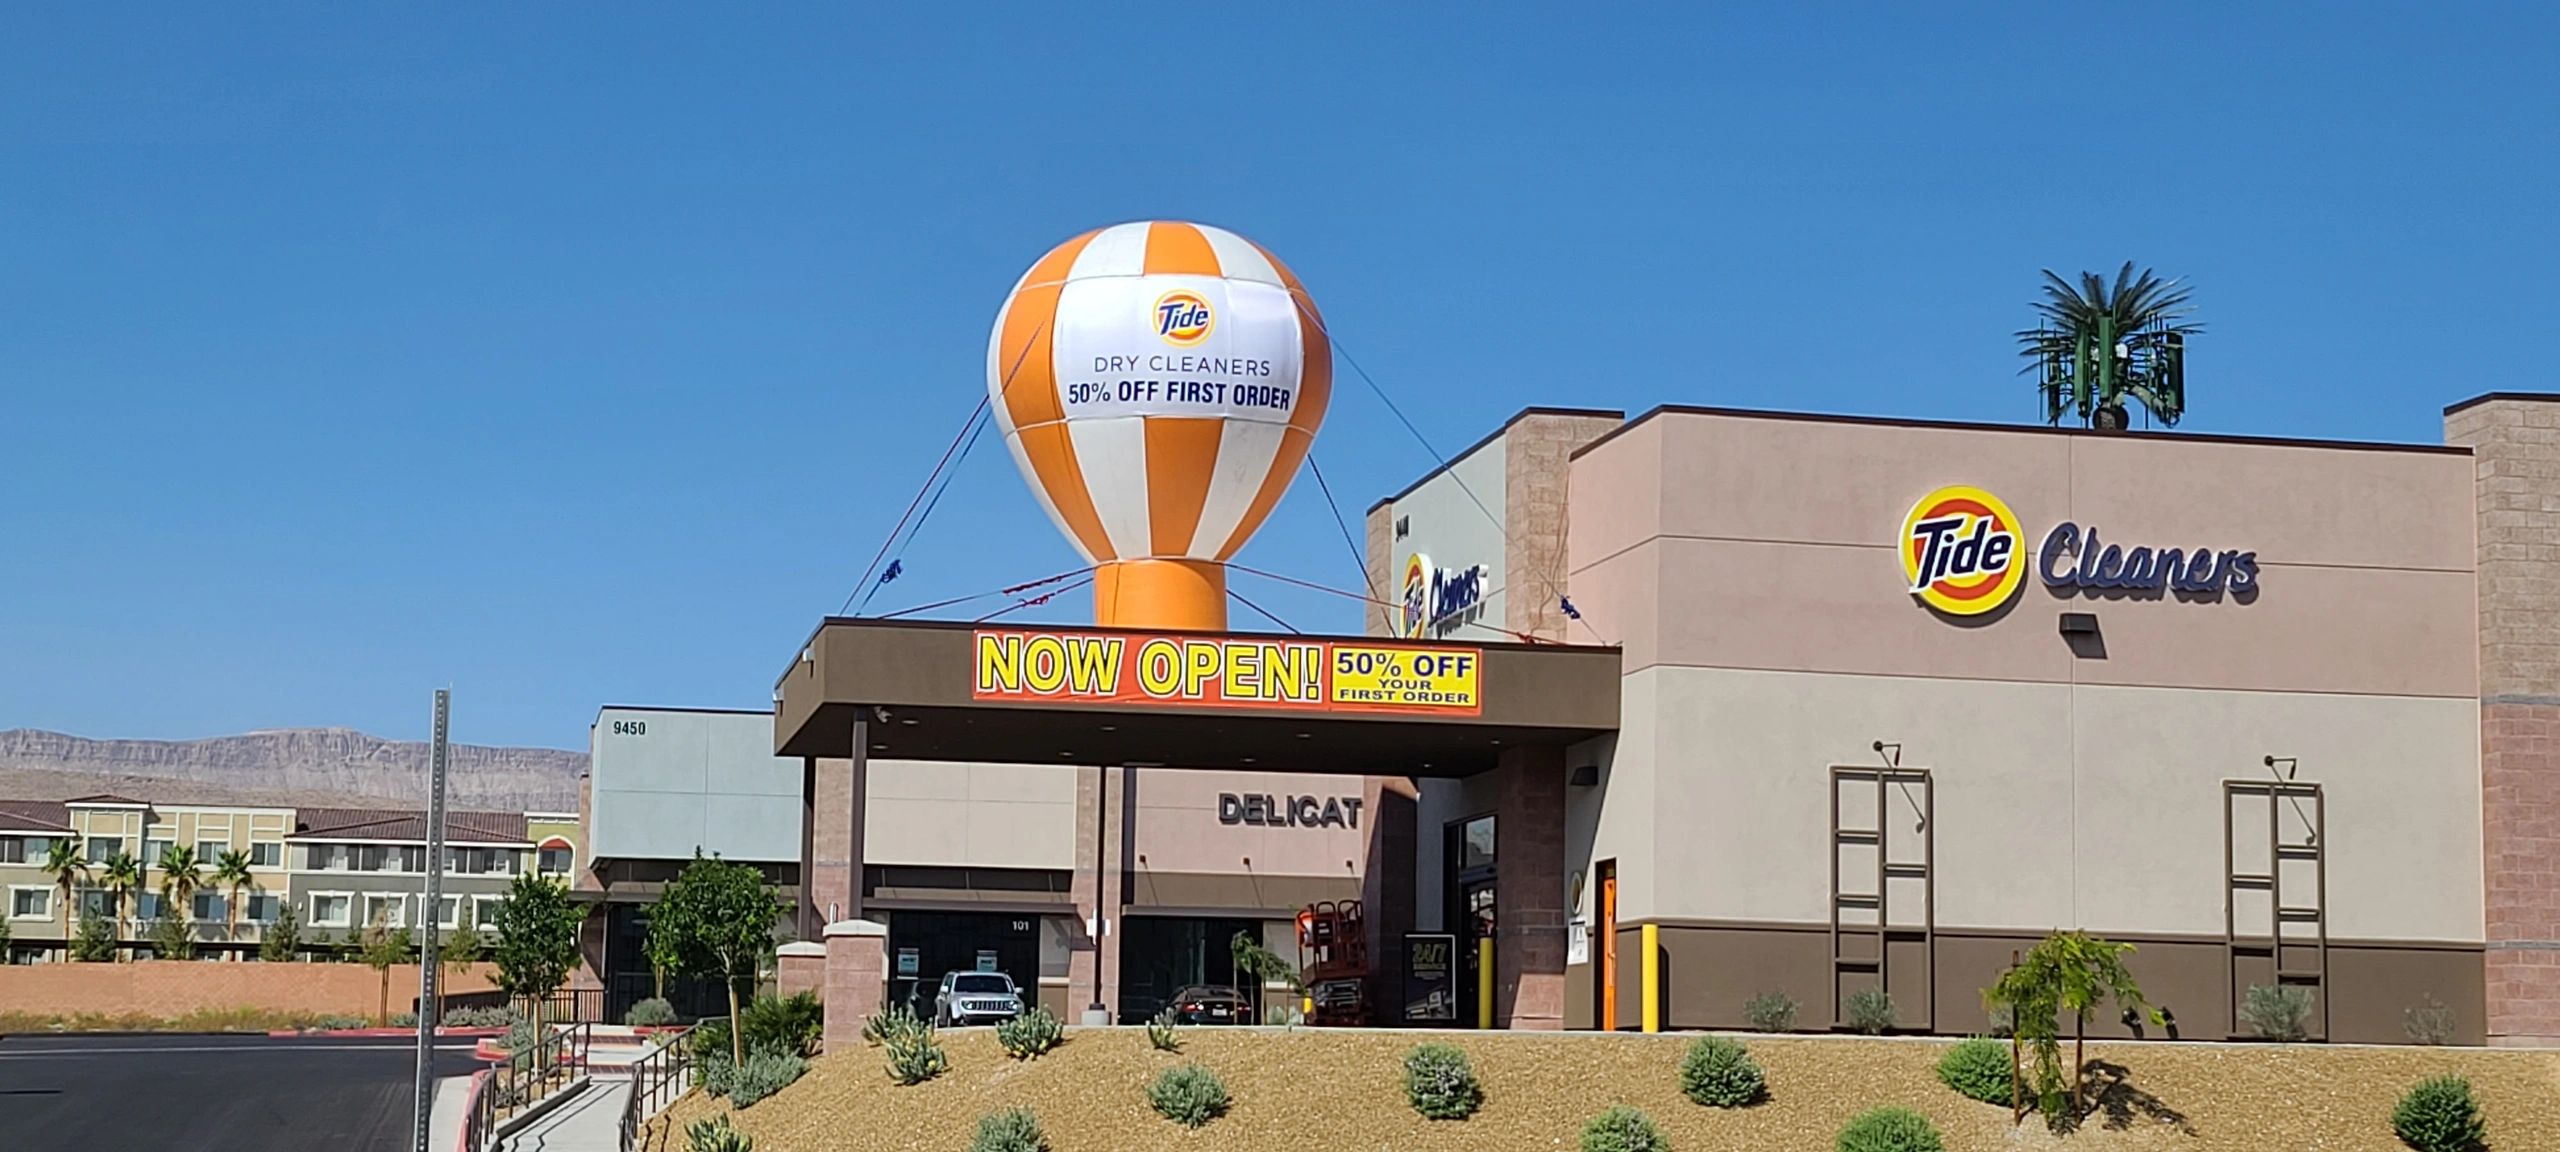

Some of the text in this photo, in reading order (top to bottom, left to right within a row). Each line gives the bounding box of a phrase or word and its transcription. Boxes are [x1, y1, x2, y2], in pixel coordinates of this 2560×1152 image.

[1159, 303, 1208, 336] Tide
[1094, 356, 1271, 376] DRY CLEANERS
[1068, 381, 1290, 411] 50% OFF FIRST ORDER
[1911, 516, 2257, 593] Tide Cleaners
[977, 635, 1321, 701] NOW OPEN!
[1337, 652, 1473, 678] 50% OFF
[1340, 689, 1469, 703] FIRST ORDER
[1379, 679, 1432, 690] YOUR
[613, 720, 646, 735] 9450
[1219, 793, 1363, 829] DELICAT
[1012, 920, 1030, 931] 101
